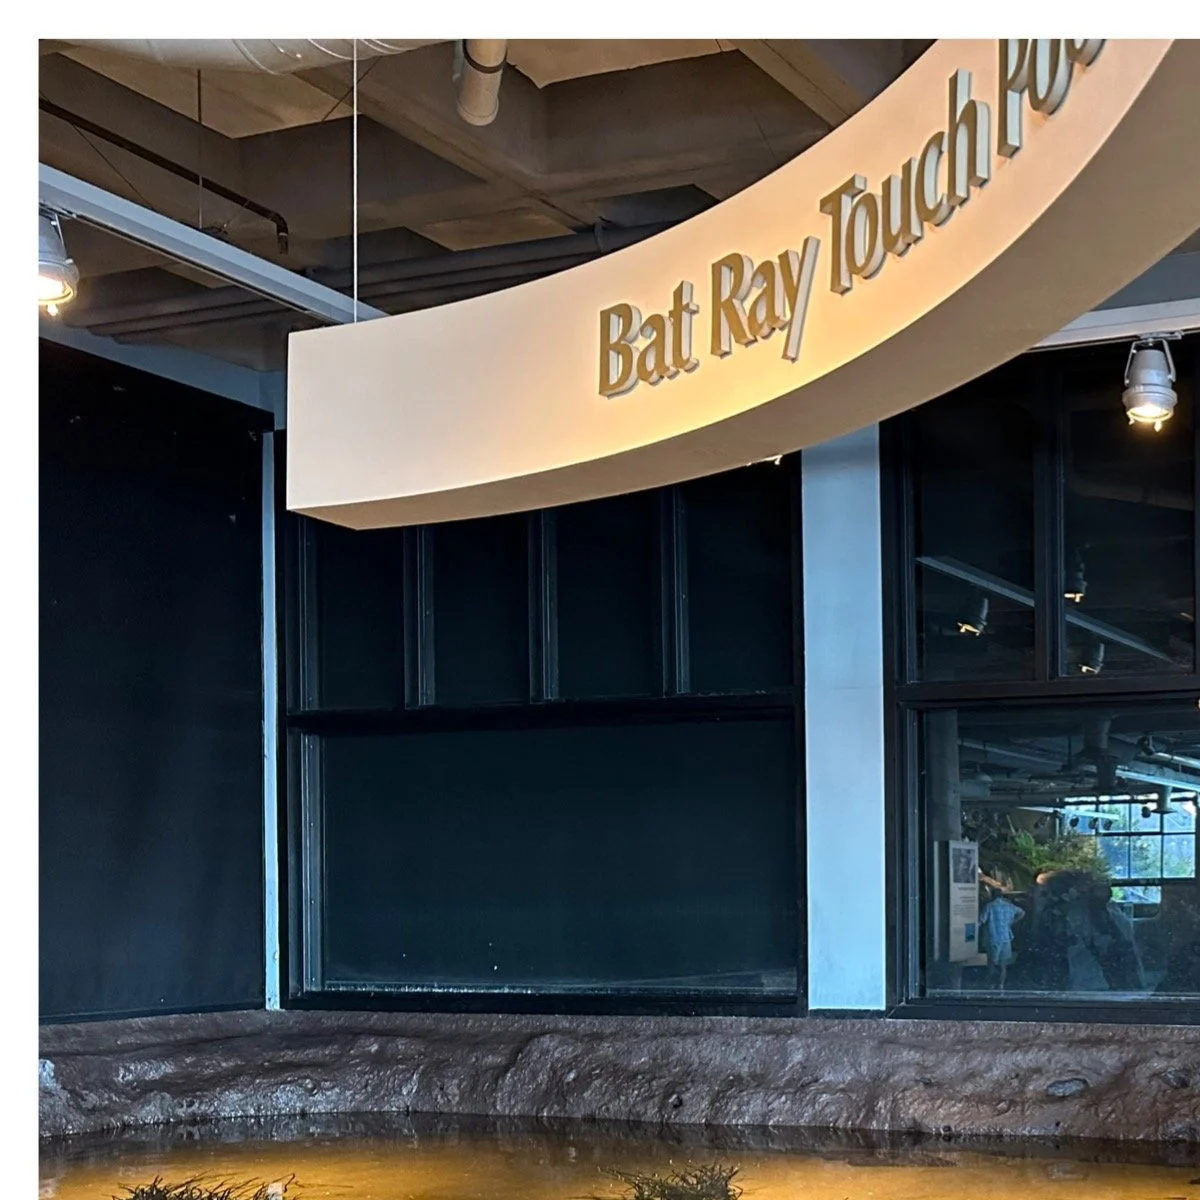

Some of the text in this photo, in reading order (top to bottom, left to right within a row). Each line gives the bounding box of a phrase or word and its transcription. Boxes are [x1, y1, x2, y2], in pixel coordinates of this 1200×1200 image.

[599, 39, 1107, 398] Bat Ray Touch Po
